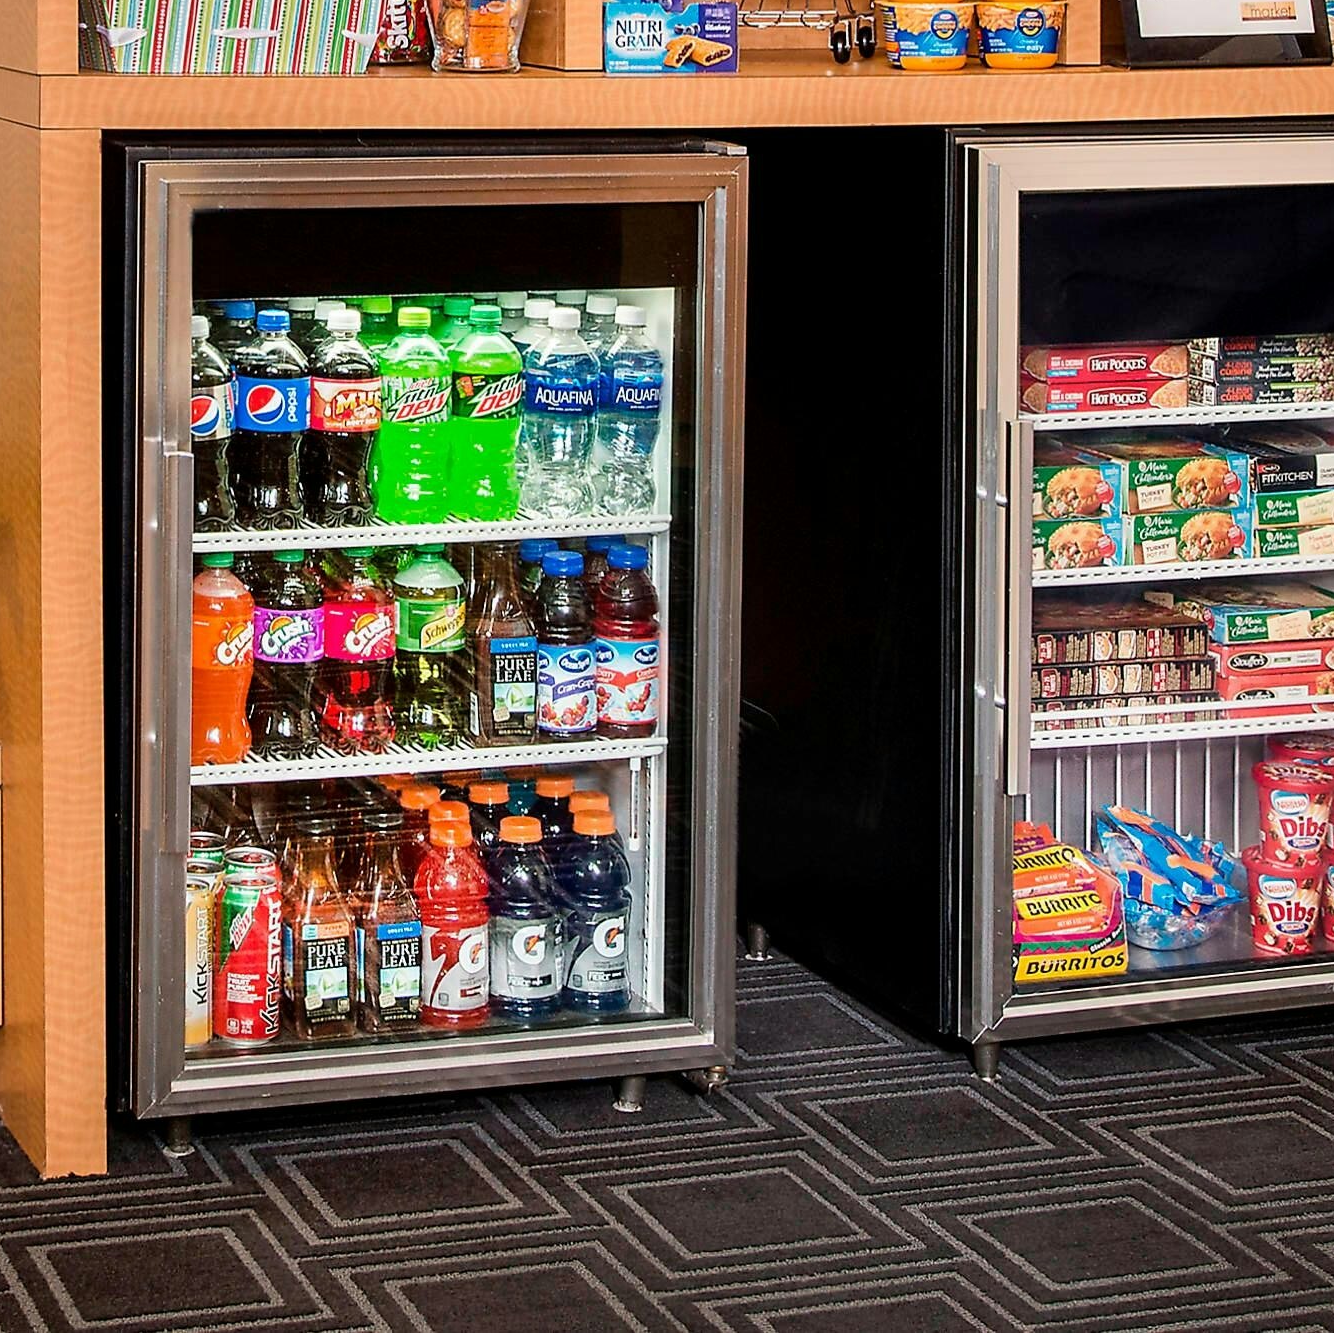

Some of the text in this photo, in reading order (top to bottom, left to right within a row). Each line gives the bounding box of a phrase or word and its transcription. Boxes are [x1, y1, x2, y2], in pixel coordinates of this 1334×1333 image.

[1250, 1, 1292, 18] market
[616, 19, 663, 36] NUTRI
[615, 33, 663, 47] GRAIN
[1091, 357, 1147, 371] HOT POCKETS
[534, 386, 594, 406] AQUAFINA
[1091, 391, 1147, 405] HOT POCKETS
[286, 387, 299, 423] pepsi
[1141, 489, 1165, 498] TURKEY
[1146, 543, 1170, 552] TURKEY
[495, 658, 535, 671] PURE
[495, 670, 532, 683] LEAF
[1279, 815, 1327, 838] Dibs
[1267, 900, 1316, 923] Dibs
[512, 924, 548, 965] G
[593, 916, 625, 958] G
[193, 907, 208, 1004] KICKSTART
[307, 943, 346, 958] PURE
[381, 942, 420, 958] PURE
[260, 897, 282, 1034] KICKSTART
[307, 955, 343, 969] LEAF
[382, 955, 417, 968] LEAF
[1026, 952, 1125, 975] BURRITOS
